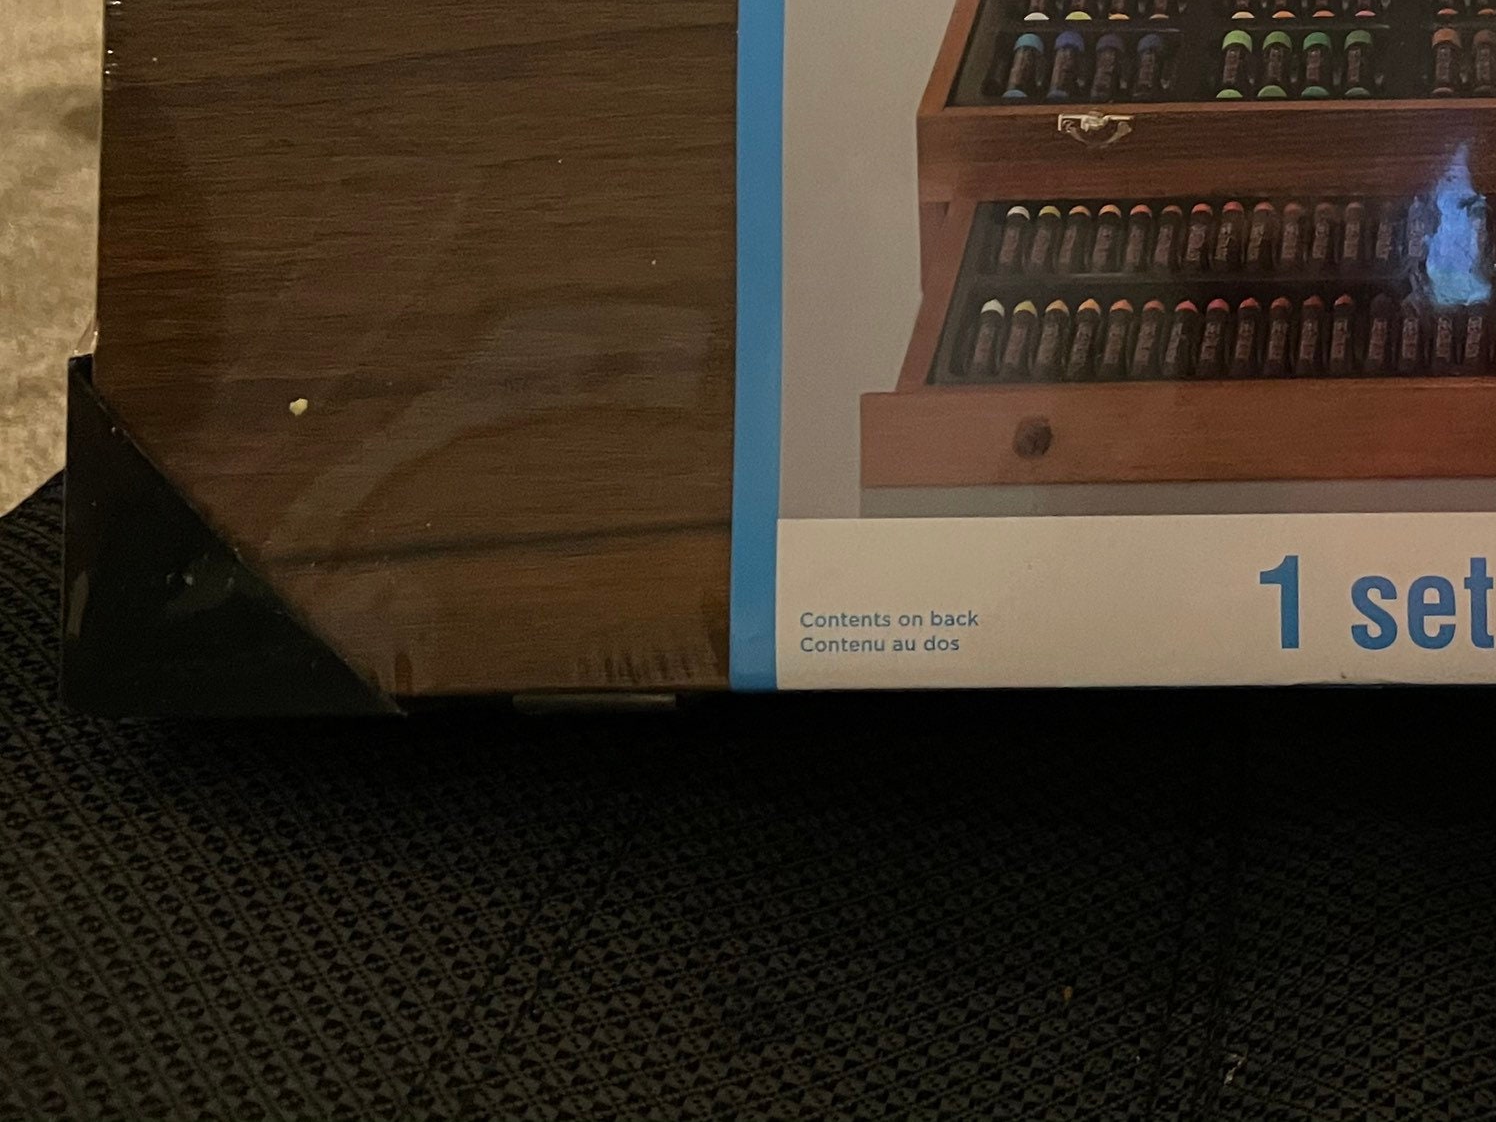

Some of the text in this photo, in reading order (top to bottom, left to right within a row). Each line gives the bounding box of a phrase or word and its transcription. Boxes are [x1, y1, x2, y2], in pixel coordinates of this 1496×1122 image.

[1258, 555, 1300, 649] 1
[1350, 557, 1494, 649] set
[800, 610, 979, 627] Contents on back
[800, 635, 960, 652] Contenu au dos
